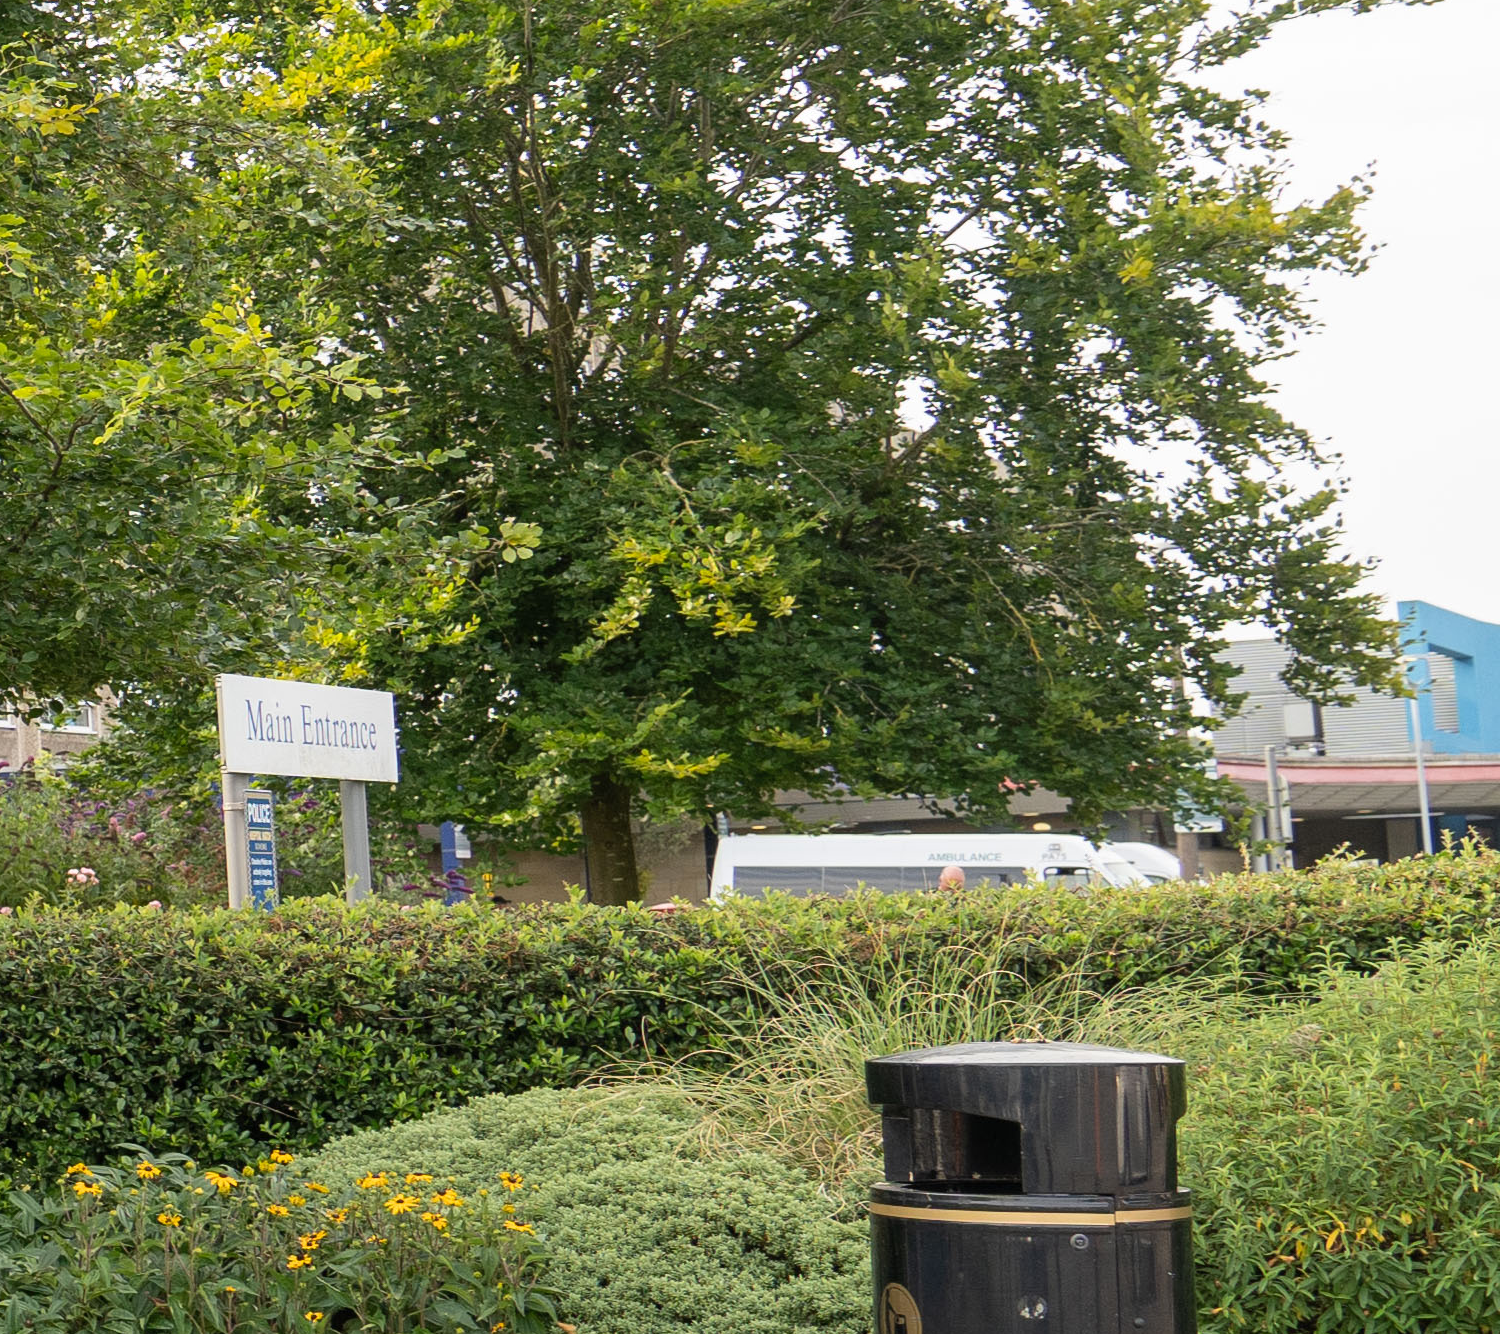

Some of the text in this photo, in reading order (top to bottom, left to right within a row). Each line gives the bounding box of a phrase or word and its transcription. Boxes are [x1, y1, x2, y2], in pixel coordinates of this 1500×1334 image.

[245, 699, 378, 750] Main Entrance
[247, 803, 271, 824] POLICE
[927, 852, 1002, 862] AMBULANCE
